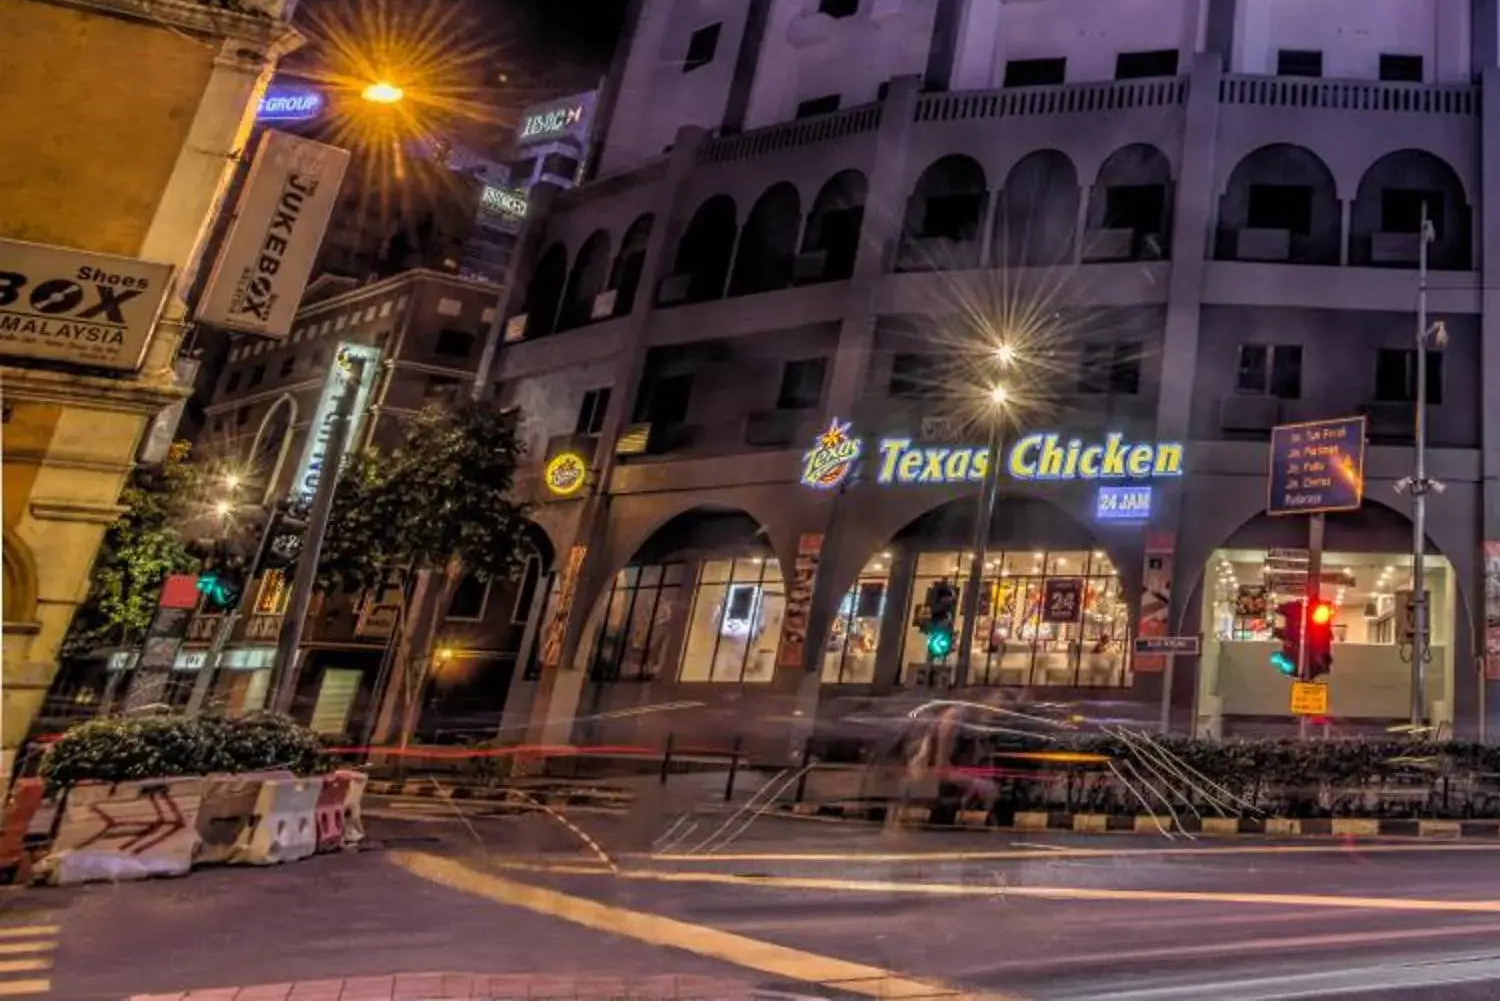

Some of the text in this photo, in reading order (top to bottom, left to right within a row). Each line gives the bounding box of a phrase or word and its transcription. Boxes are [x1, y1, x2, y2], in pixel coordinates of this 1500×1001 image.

[242, 174, 304, 322] JUKEBOX
[78, 265, 149, 289] Shoes
[0, 315, 125, 346] MALAYSIA
[878, 436, 990, 484] Texas
[1008, 430, 1184, 480] Chicken
